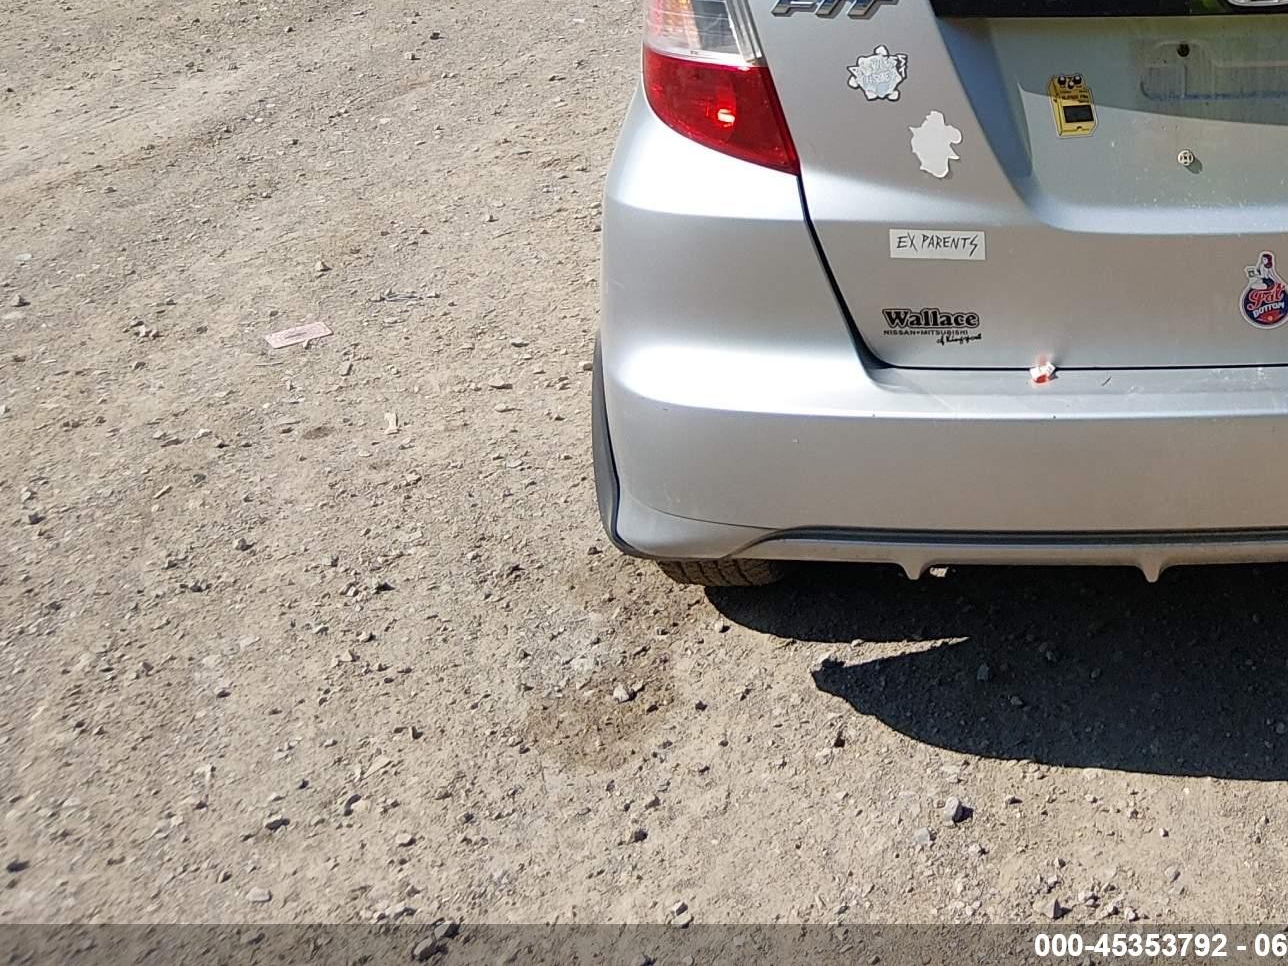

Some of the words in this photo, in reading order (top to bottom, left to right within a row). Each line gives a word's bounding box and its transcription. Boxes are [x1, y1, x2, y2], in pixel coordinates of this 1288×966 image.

[896, 232, 919, 251] EX
[921, 234, 978, 257] PARENTS
[882, 308, 979, 328] Wallace
[1252, 301, 1285, 318] BOTTOM
